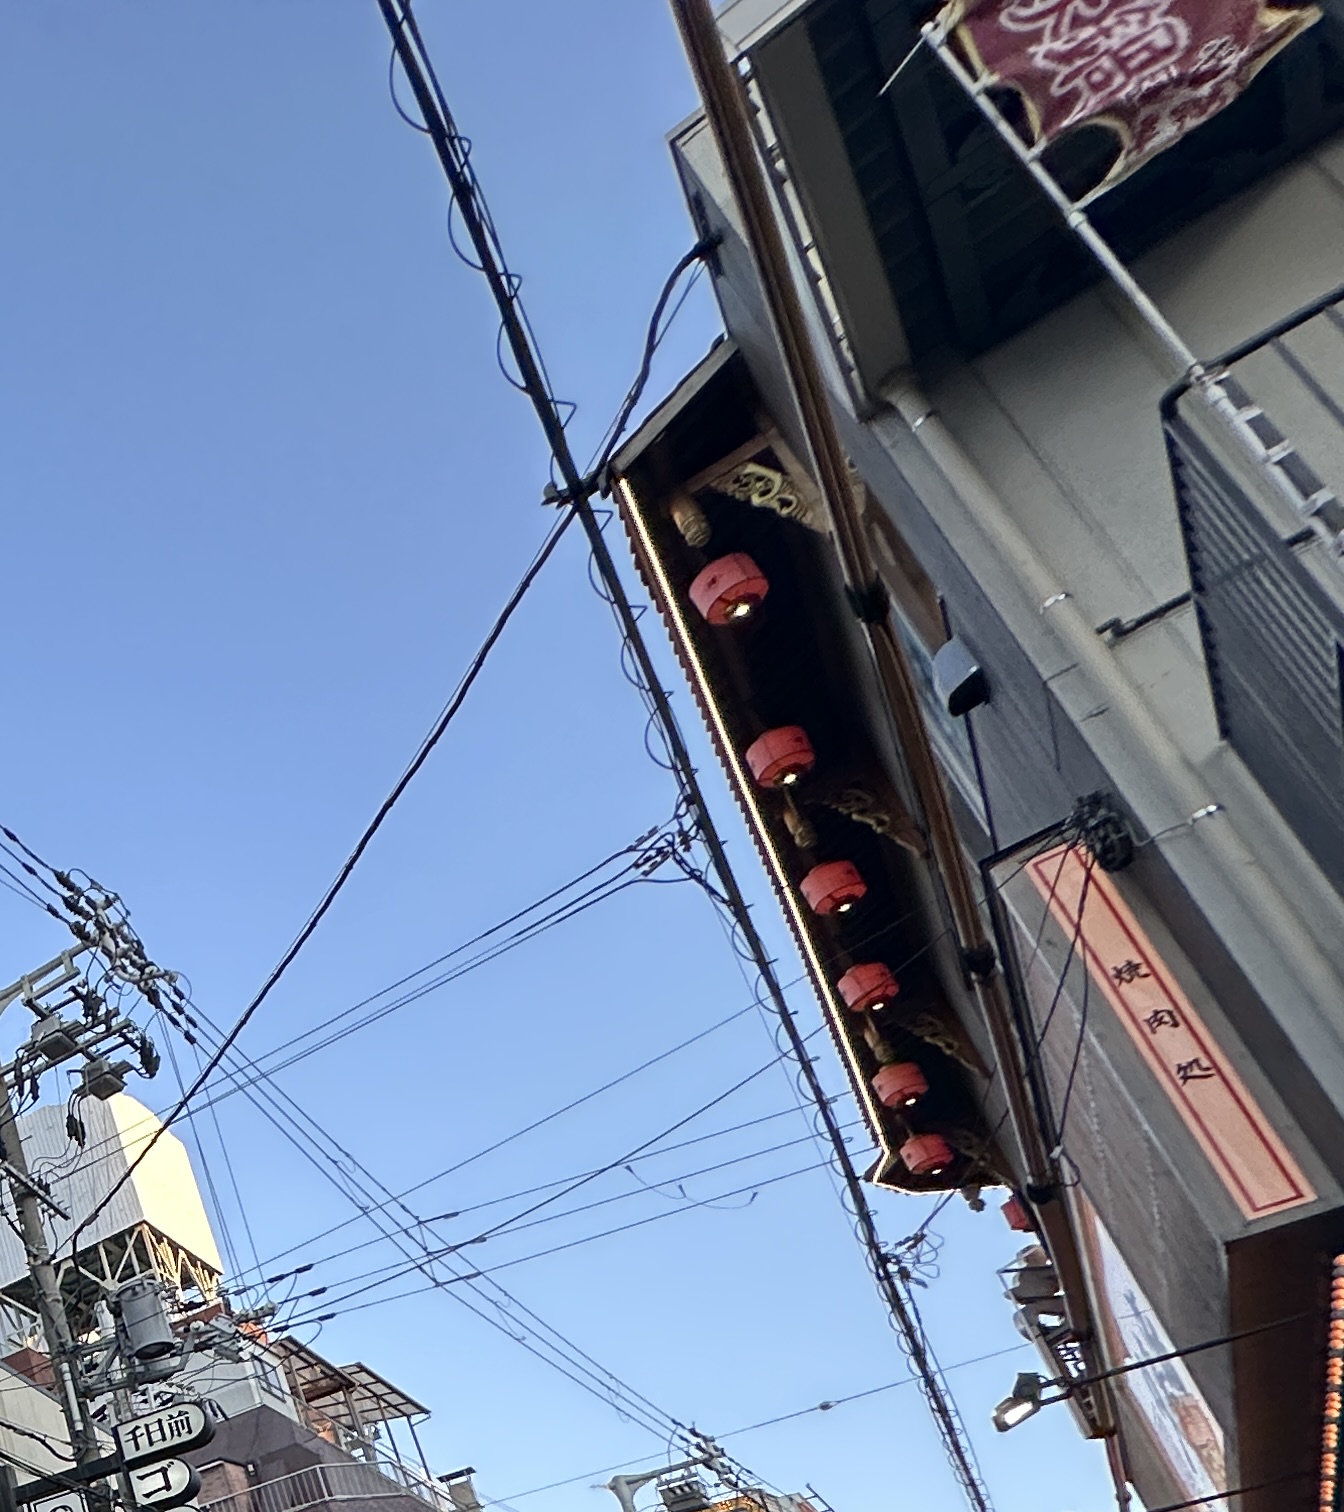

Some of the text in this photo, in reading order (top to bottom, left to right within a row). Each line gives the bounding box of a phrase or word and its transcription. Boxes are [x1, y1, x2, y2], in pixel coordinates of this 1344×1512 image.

[1110, 960, 1215, 1087] 焼肉処
[123, 1409, 193, 1452] 千日前
